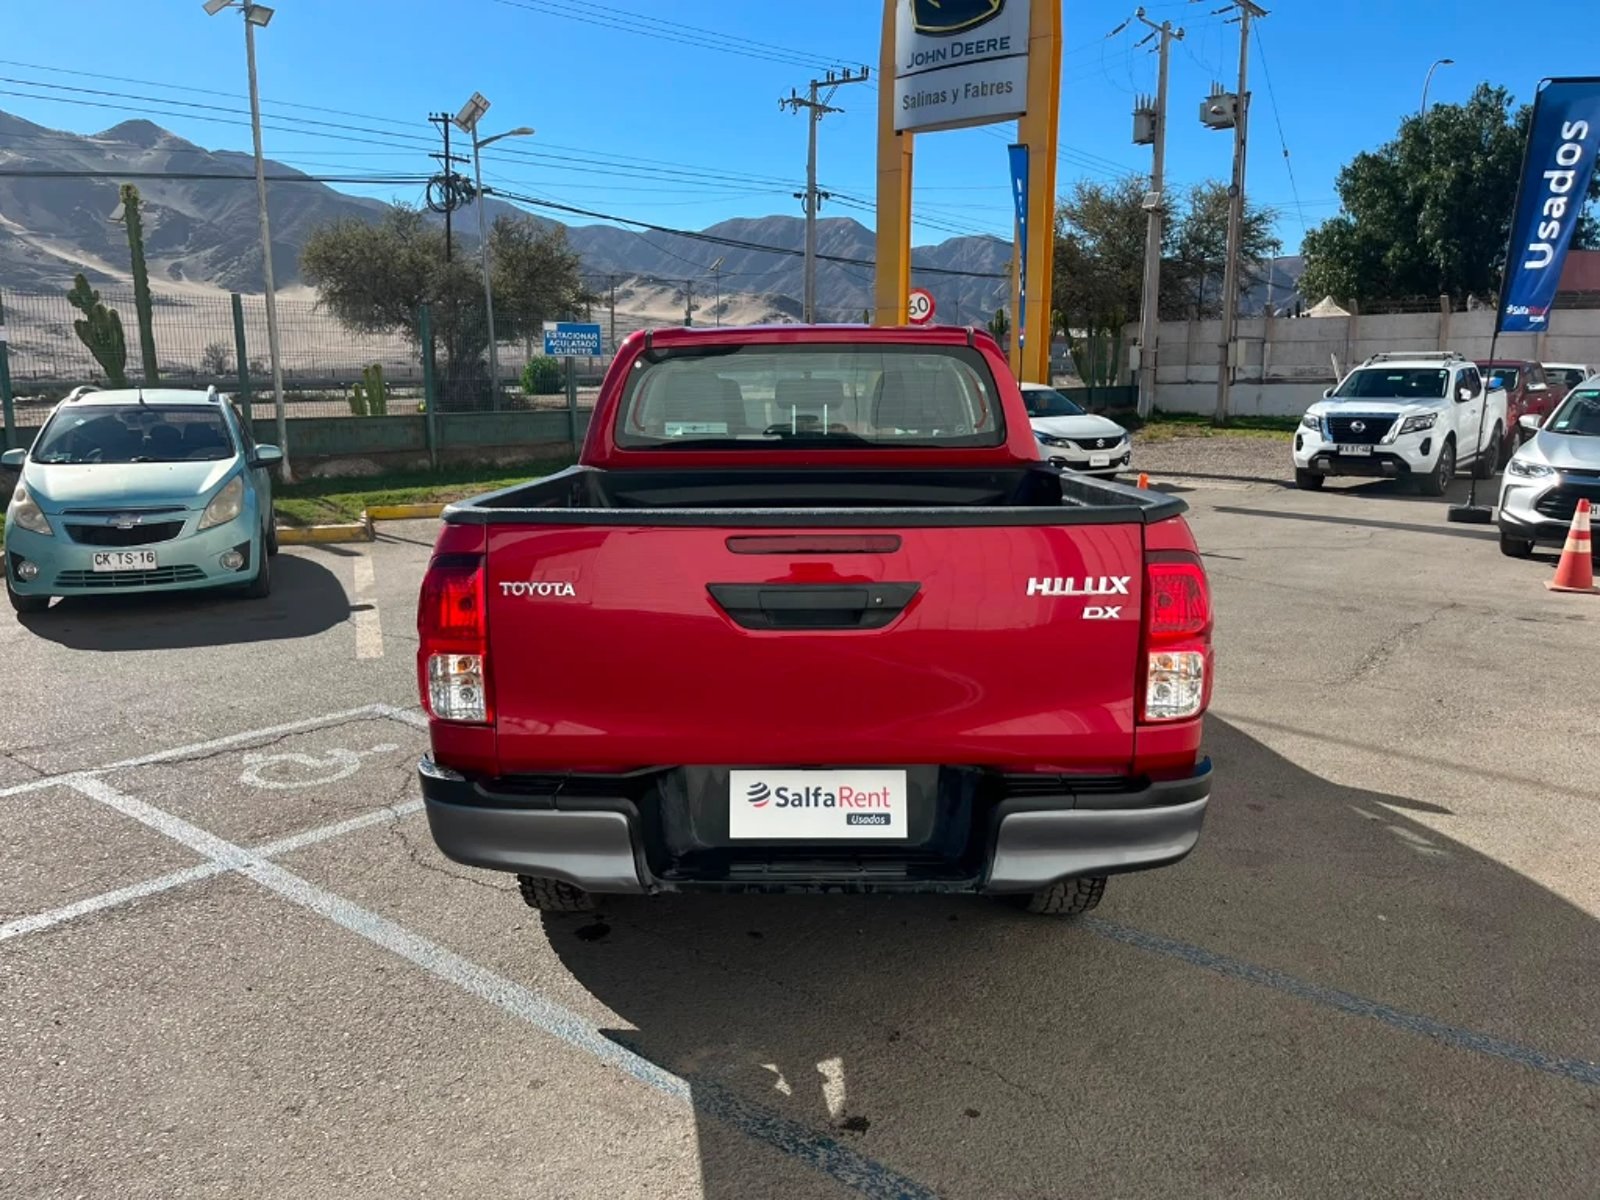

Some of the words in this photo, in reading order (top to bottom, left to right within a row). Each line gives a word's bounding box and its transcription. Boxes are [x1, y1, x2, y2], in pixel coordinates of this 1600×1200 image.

[906, 48, 946, 69] JOHN
[951, 36, 1011, 58] DEERE
[902, 90, 947, 110] Salinas
[952, 87, 959, 104] y
[964, 80, 1013, 99] Fabres
[1524, 119, 1589, 270] Usados
[499, 581, 576, 597] TOYOTA
[1026, 576, 1131, 596] HILUX
[1082, 606, 1122, 620] DX
[775, 786, 891, 808] SalfaRent
[851, 814, 886, 825] Usados
